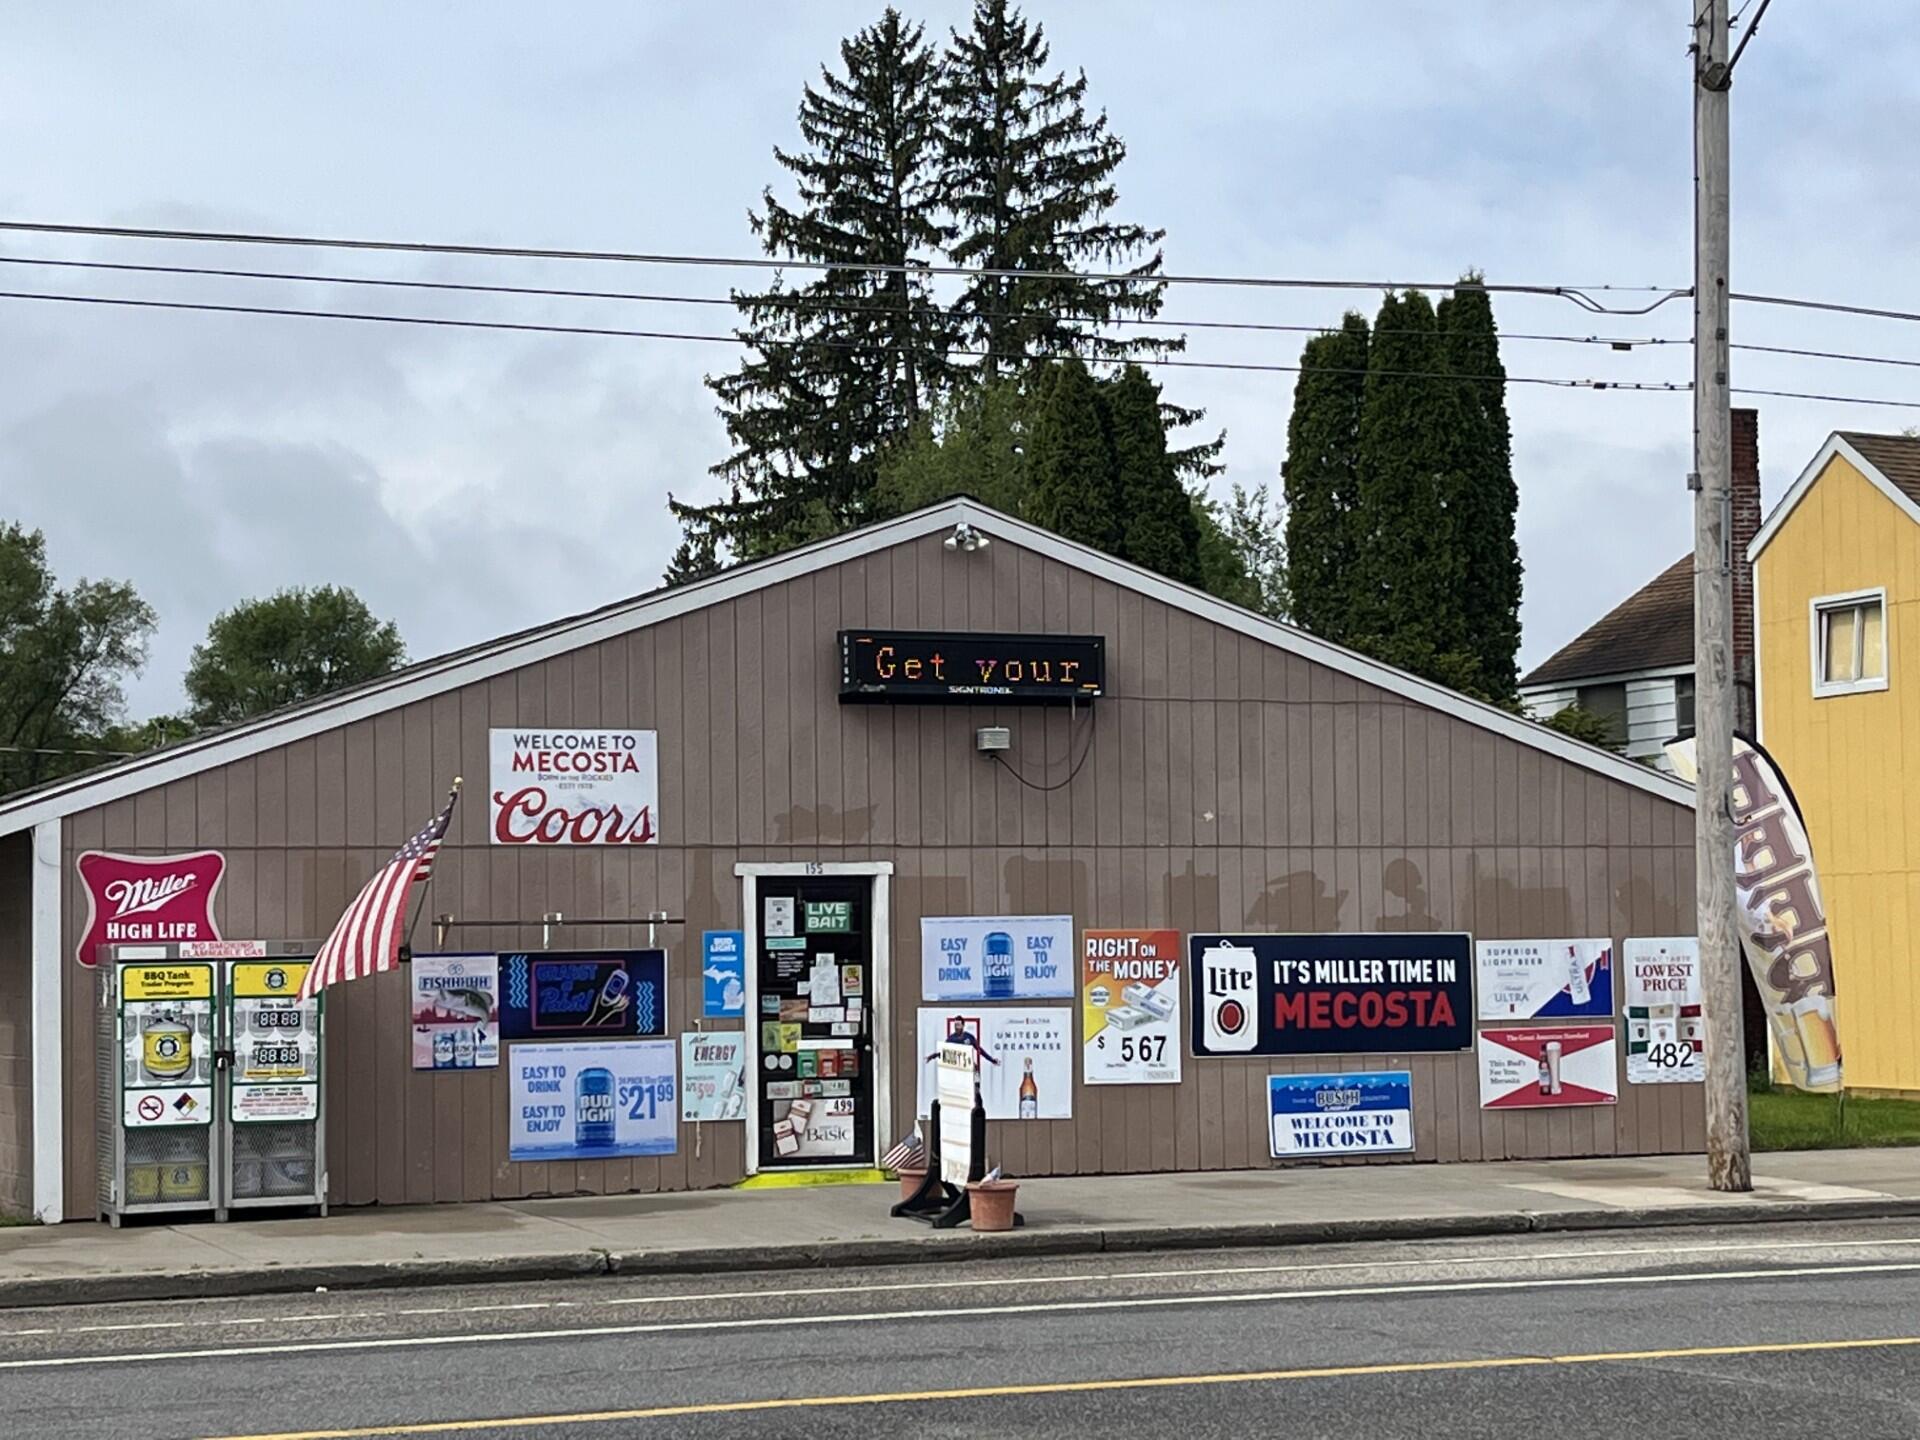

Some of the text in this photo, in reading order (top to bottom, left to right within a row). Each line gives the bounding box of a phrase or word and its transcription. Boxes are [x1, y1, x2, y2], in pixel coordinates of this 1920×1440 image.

[875, 647, 944, 681] Get
[975, 660, 1079, 682] your
[514, 735, 636, 750] WELCOME TO
[512, 751, 640, 773] MECOSTA
[493, 787, 656, 843] Coors
[806, 863, 823, 874] 155
[105, 873, 198, 915] Miller
[808, 903, 847, 914] LIVE
[808, 916, 847, 928] BAIT
[107, 922, 197, 939] HIGH LIFE
[941, 938, 967, 951] EASY
[1027, 936, 1053, 949] EASY
[1086, 938, 1156, 958] RIGHT ON
[244, 948, 264, 956] GAS
[947, 953, 962, 965] TO
[1034, 951, 1048, 964] TO
[1487, 948, 1538, 956] SUPERIOR
[986, 954, 1012, 965] BUD
[1518, 958, 1543, 966] BEER
[144, 971, 191, 981] BBQ Tank
[938, 968, 971, 981] DRINK
[1025, 966, 1057, 979] ENJOY
[1088, 959, 1176, 980] THE MONEY
[1273, 959, 1456, 984] IT'S MILLER TIME IN
[1635, 963, 1694, 977] LOWEST
[1208, 966, 1253, 997] Lite
[1643, 978, 1687, 992] PRICE
[1494, 993, 1529, 1002] ULTRA
[1274, 991, 1456, 1029] MECOSTA
[996, 1031, 1059, 1039] UNITED BY
[694, 1045, 736, 1061] ENERGY
[994, 1043, 1061, 1051] GREATNESS
[1648, 1043, 1694, 1068] 482
[522, 1066, 566, 1080] EASY TO
[528, 1081, 561, 1093] DRINK
[580, 1095, 612, 1109] BUD
[1316, 1090, 1360, 1106] BUSCH
[522, 1105, 566, 1119] EASY TO
[834, 1100, 852, 1111] 499
[577, 1108, 615, 1122] LIGHT
[1291, 1114, 1394, 1130] WELCOME TO
[527, 1119, 561, 1132] ENJOY
[1294, 1129, 1395, 1149] MECOSTA
